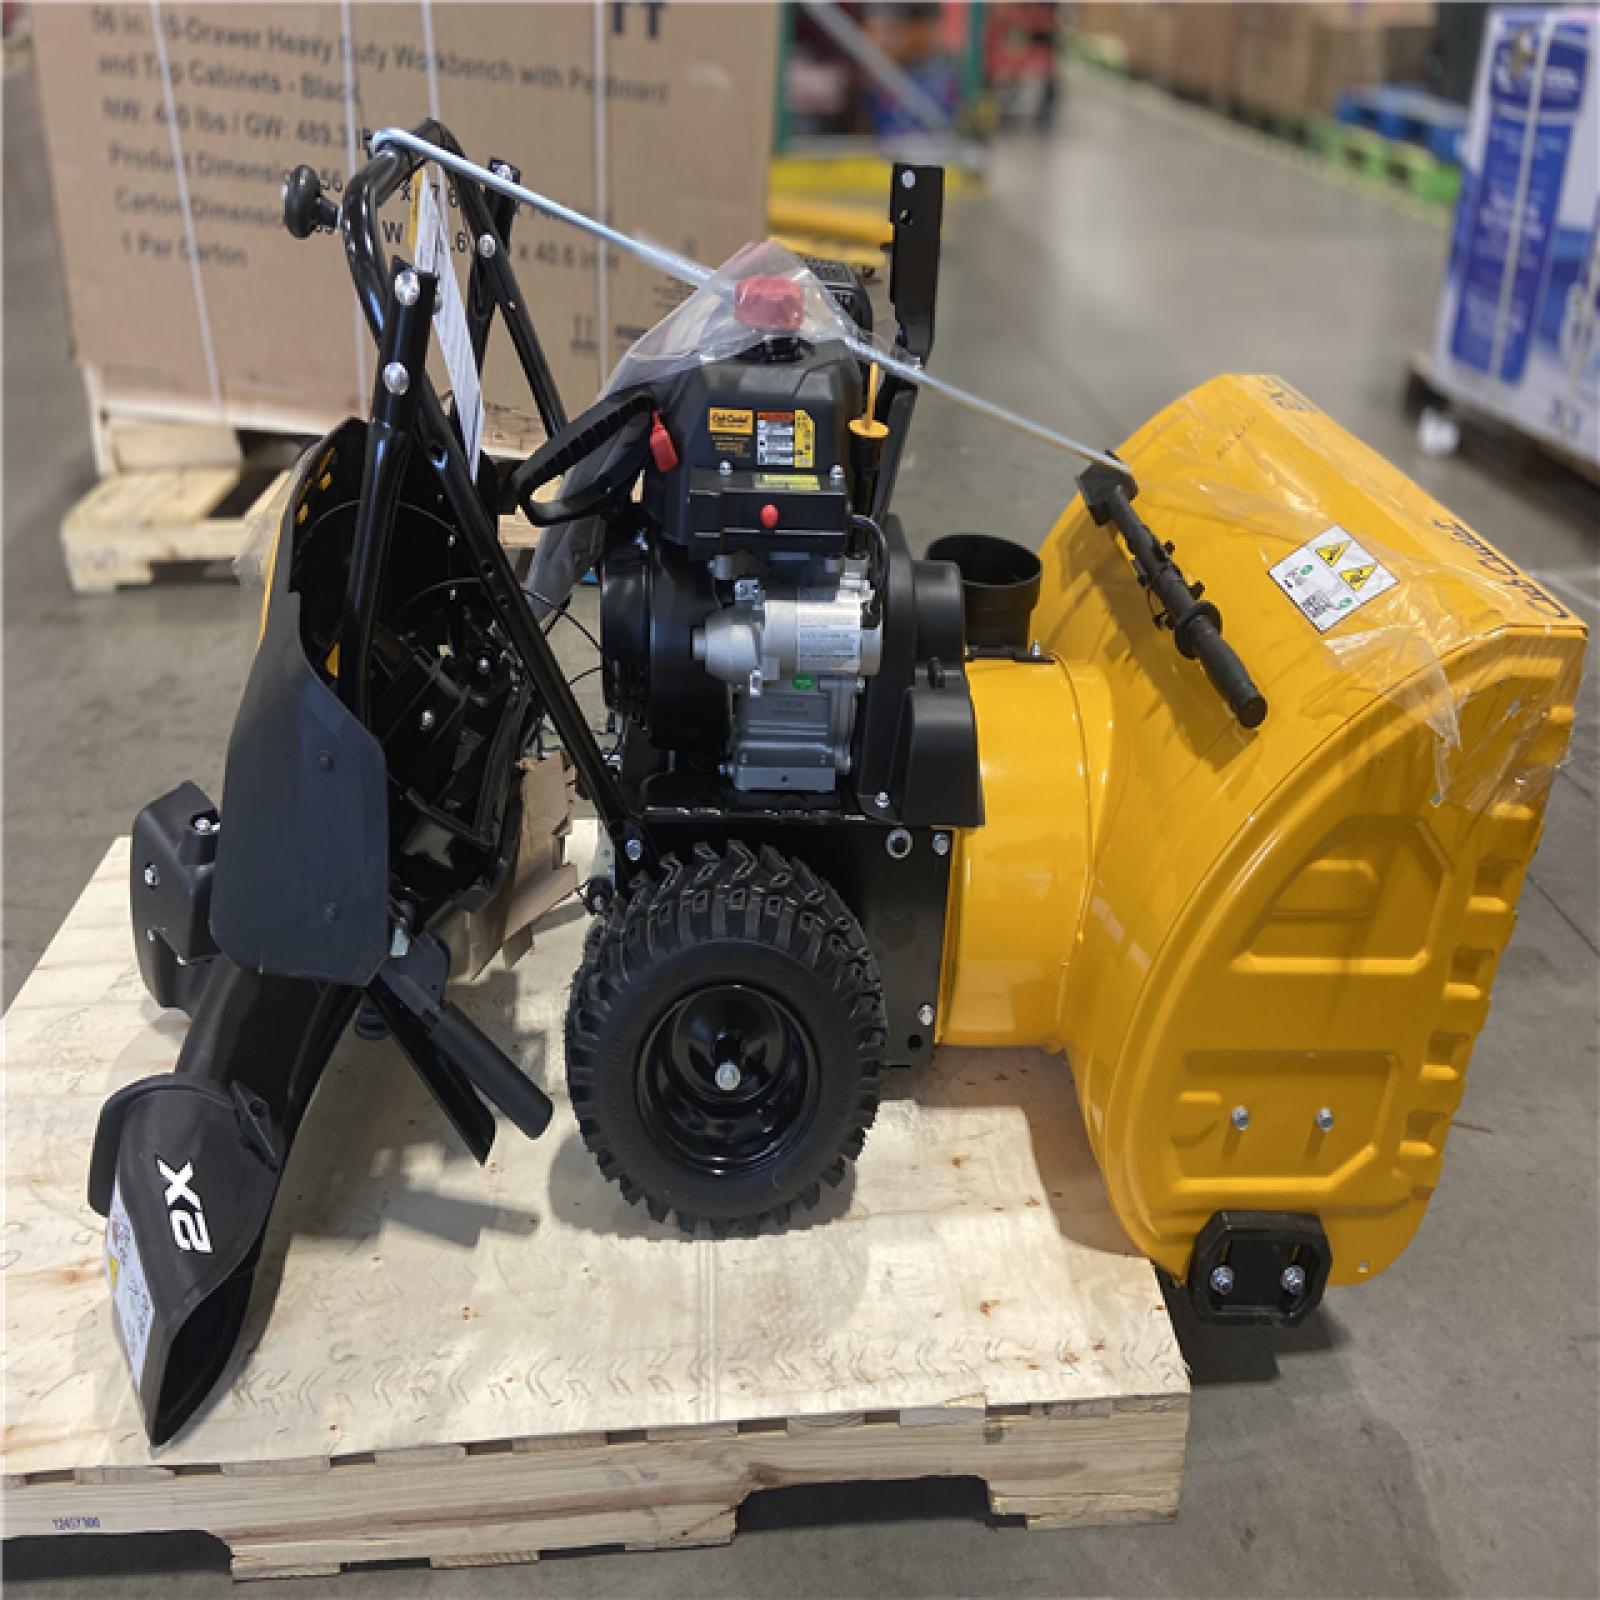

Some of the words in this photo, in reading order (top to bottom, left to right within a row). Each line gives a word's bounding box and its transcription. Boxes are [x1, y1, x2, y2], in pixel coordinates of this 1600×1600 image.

[188, 58, 282, 94] Cabinets
[393, 43, 514, 82] Wokbench
[568, 65, 670, 106] Peboard
[108, 140, 191, 176] Produt
[156, 1158, 214, 1252] X2
